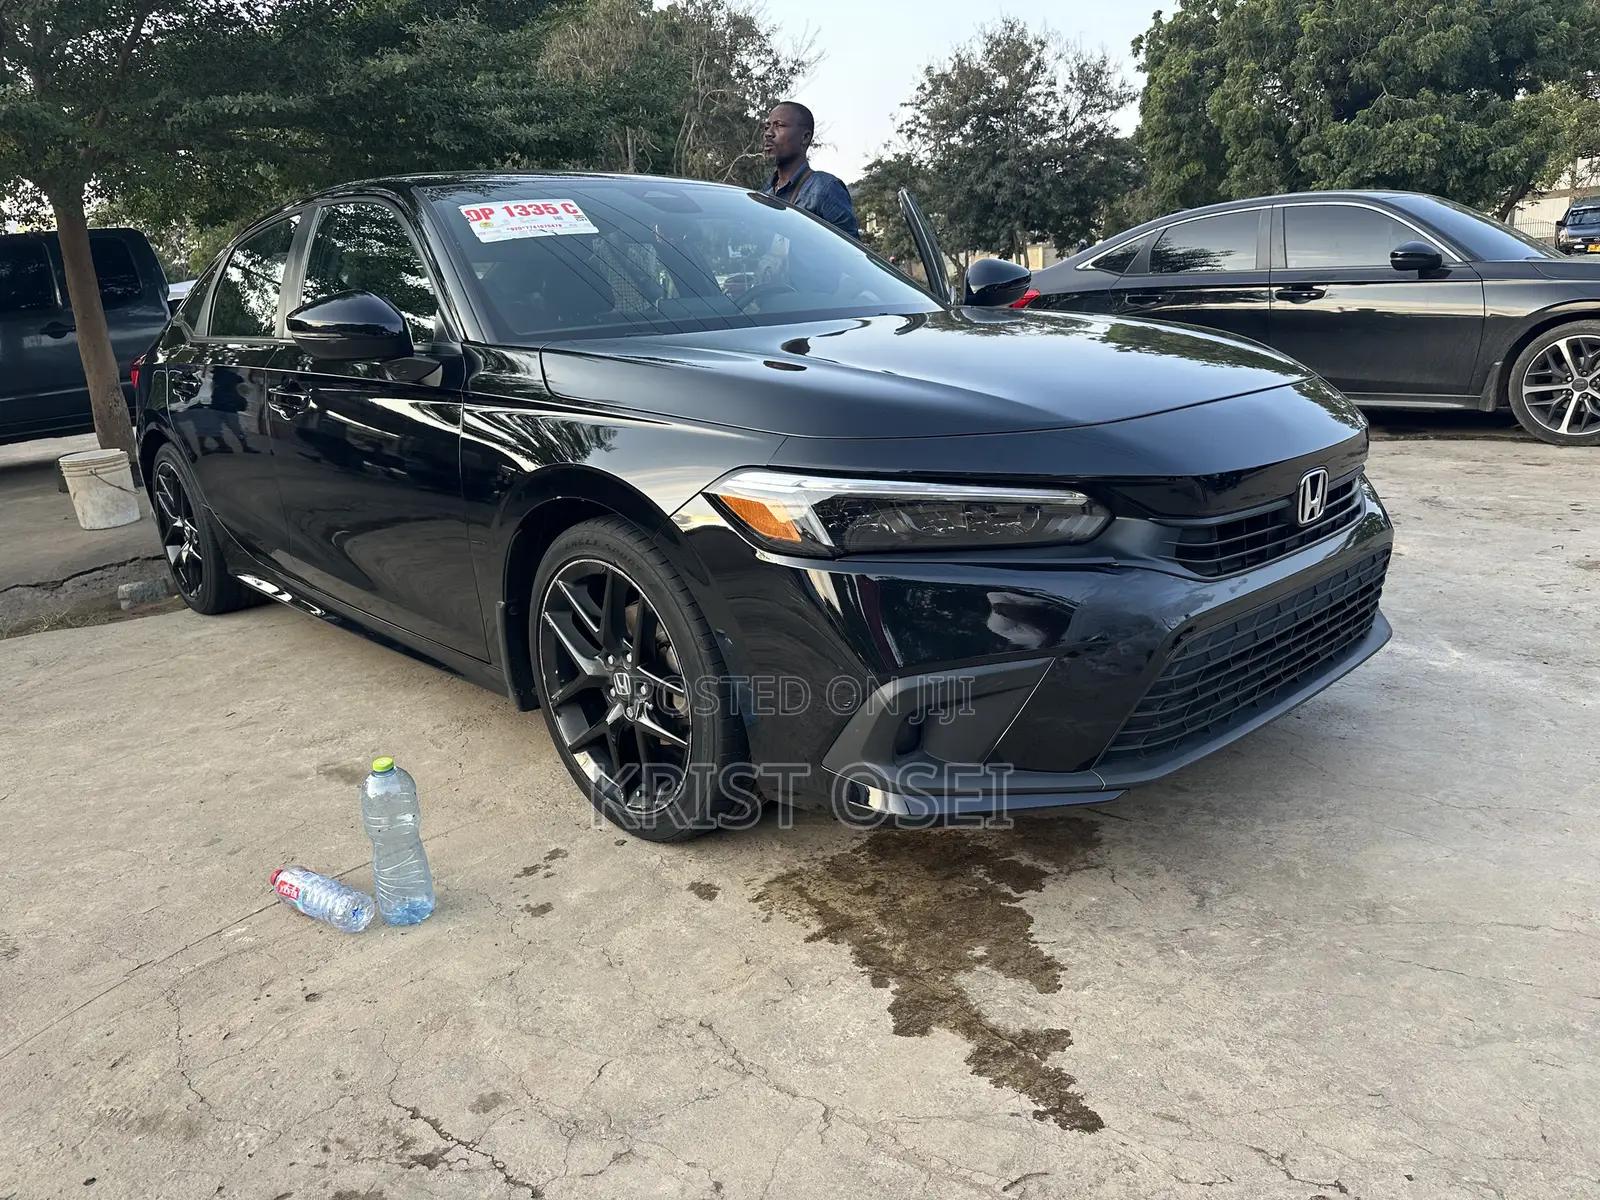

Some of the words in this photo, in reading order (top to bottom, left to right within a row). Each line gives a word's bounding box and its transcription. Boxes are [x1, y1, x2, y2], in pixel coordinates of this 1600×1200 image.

[464, 207, 495, 222] DP
[502, 203, 559, 218] 1335
[560, 203, 579, 215] C
